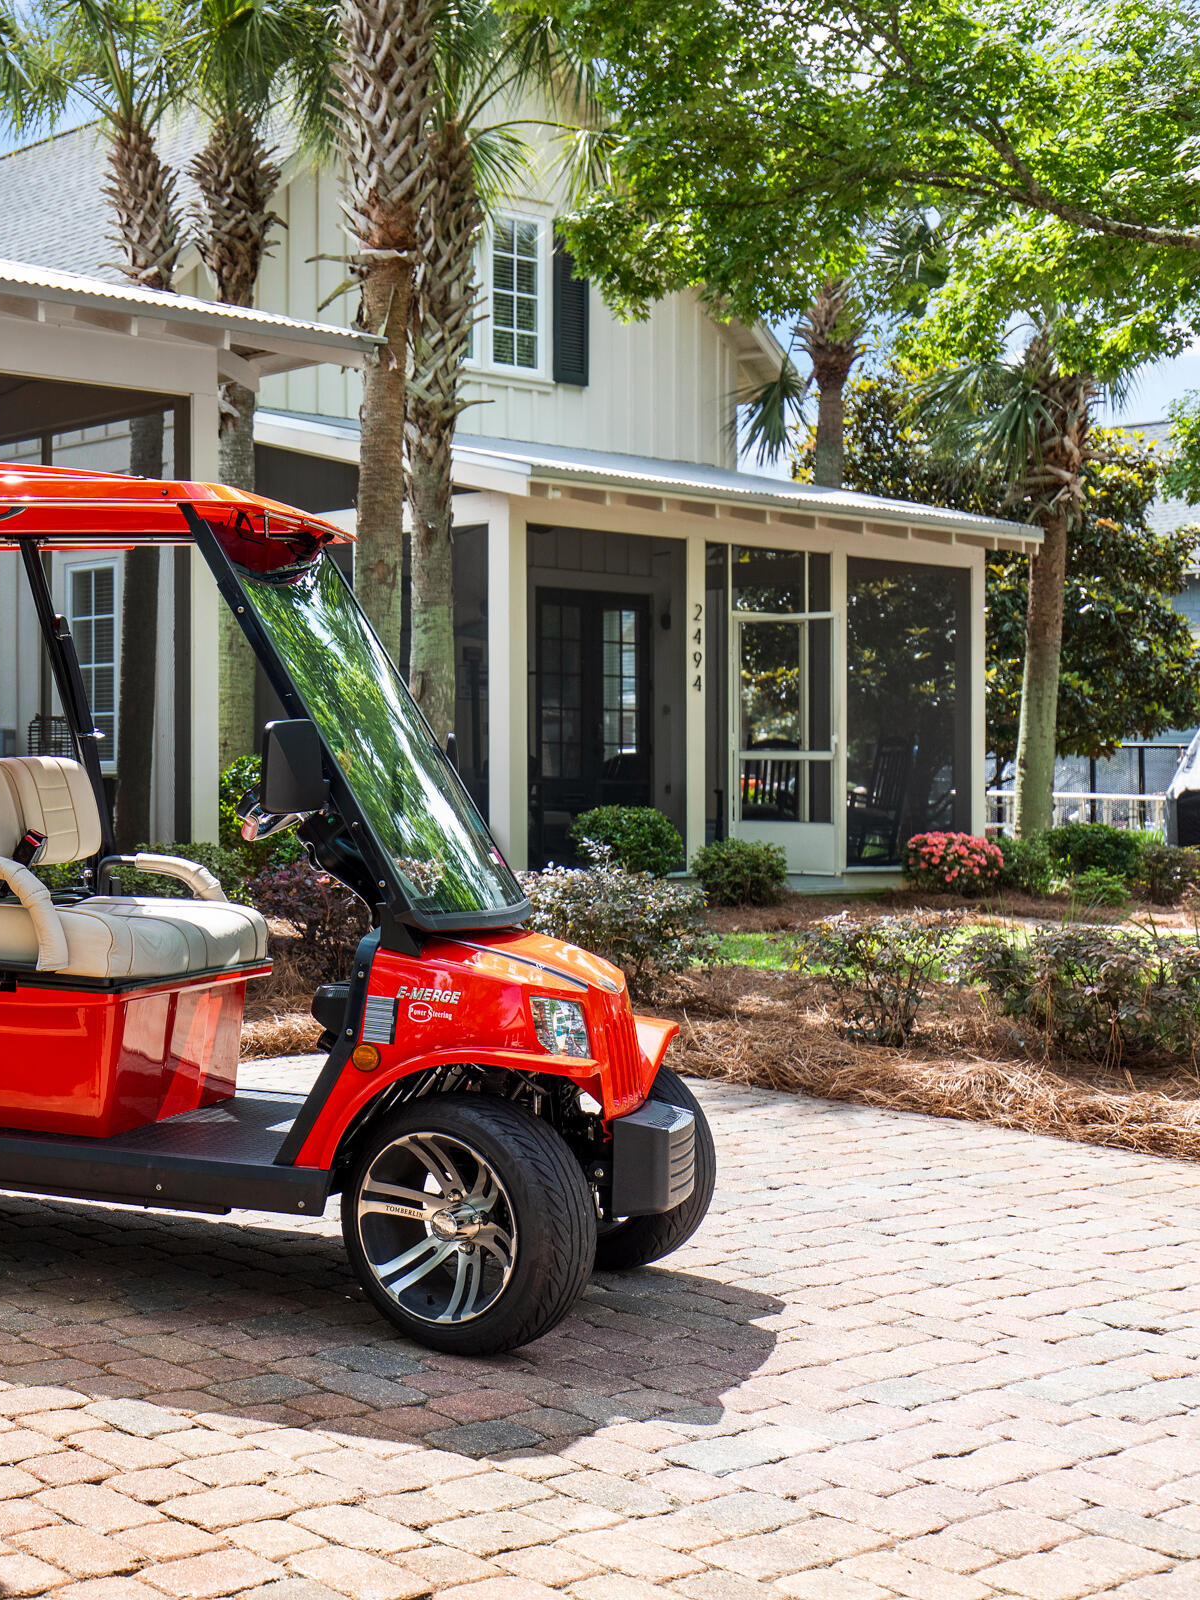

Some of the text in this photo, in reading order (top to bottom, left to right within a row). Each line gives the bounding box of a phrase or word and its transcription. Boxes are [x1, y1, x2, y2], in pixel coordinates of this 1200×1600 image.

[692, 603, 703, 692] 2494
[396, 985, 462, 1005] E-MERGE
[408, 1007, 453, 1021] Power Steering
[385, 1204, 424, 1218] TOMBERLIN
